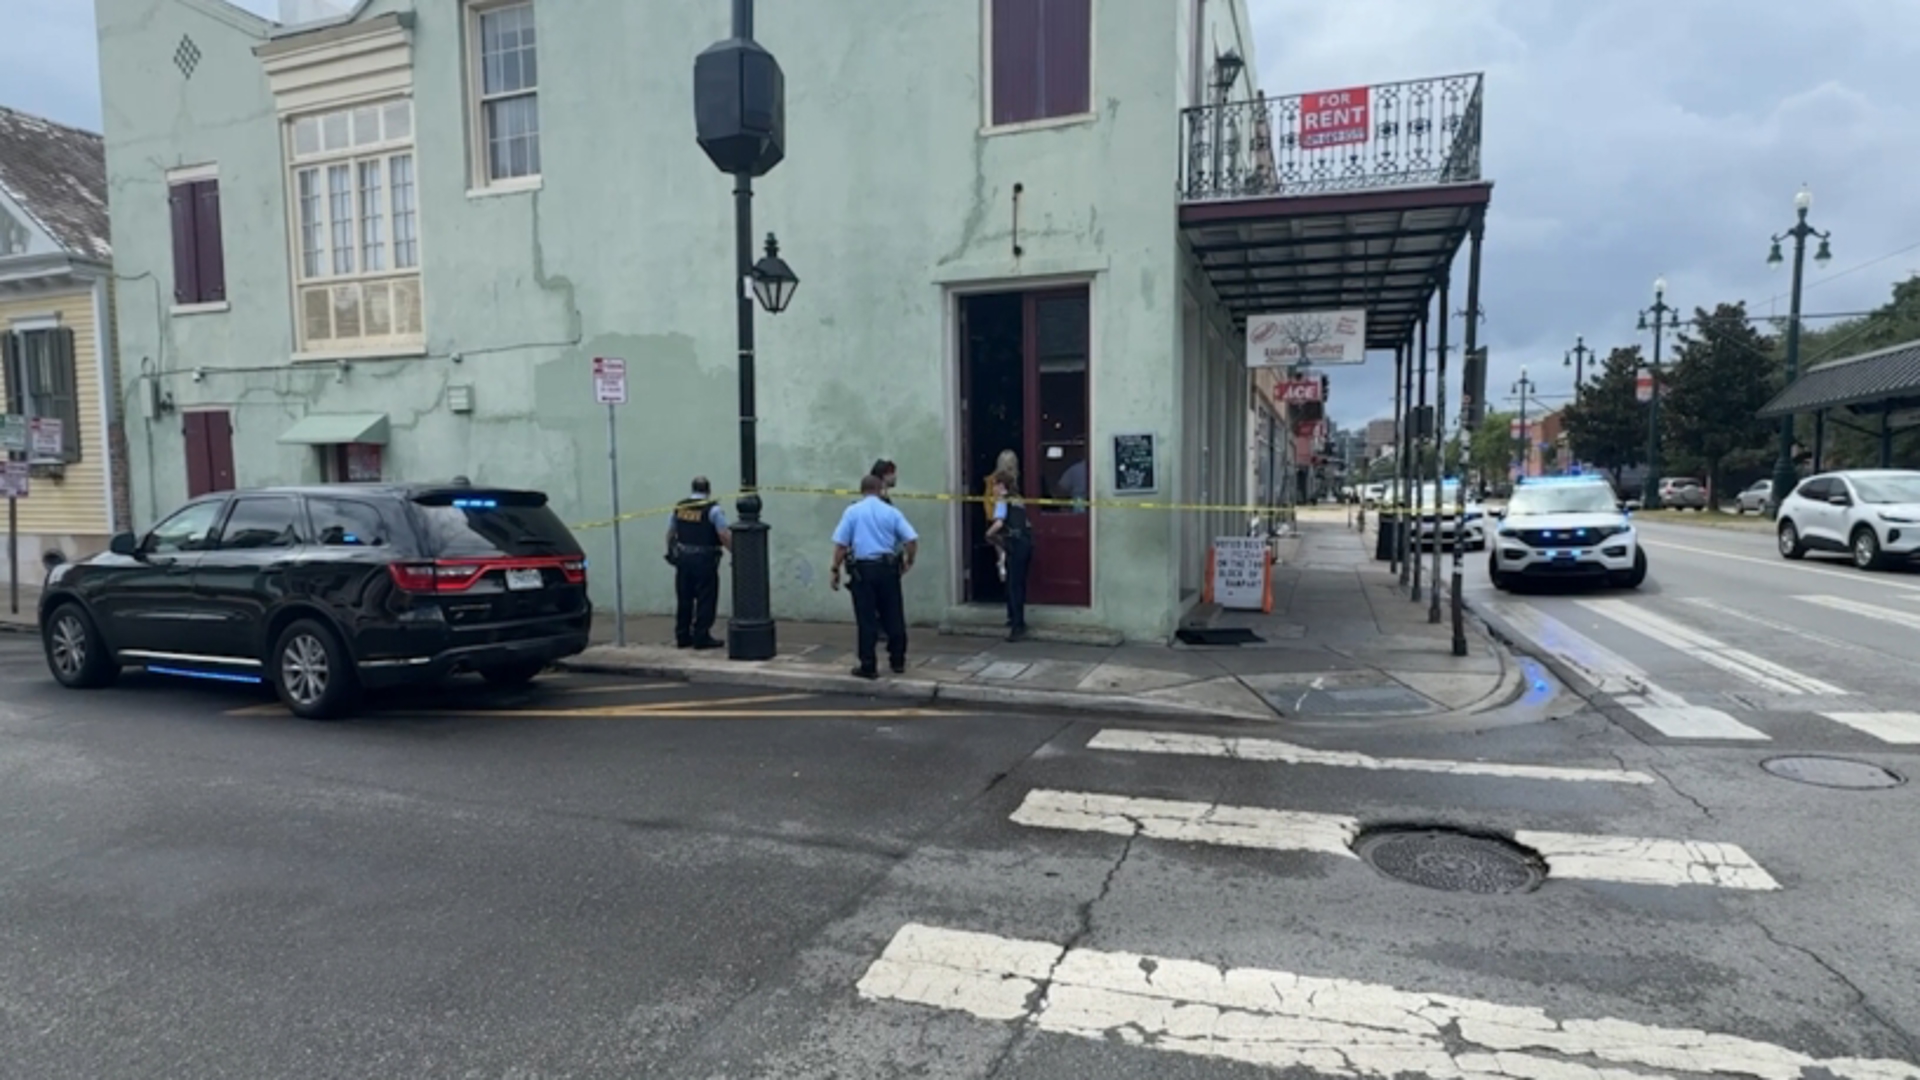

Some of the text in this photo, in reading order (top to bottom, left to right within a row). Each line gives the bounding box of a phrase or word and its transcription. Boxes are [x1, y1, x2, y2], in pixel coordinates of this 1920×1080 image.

[1318, 93, 1351, 108] FOR
[1305, 105, 1366, 130] RENT
[1281, 384, 1317, 401] ACE
